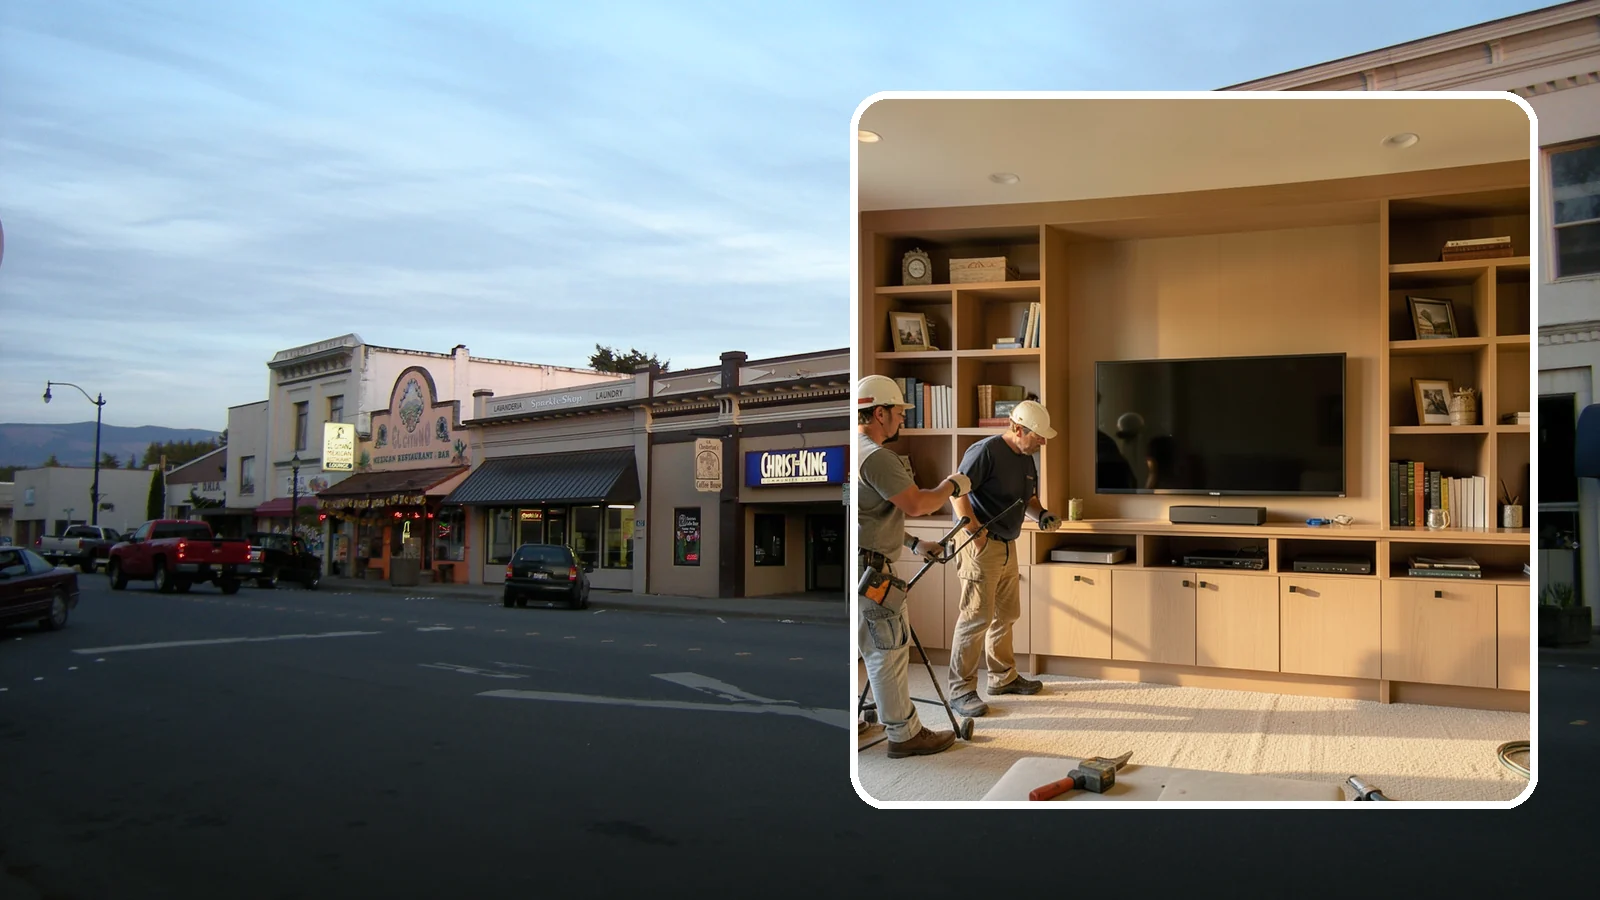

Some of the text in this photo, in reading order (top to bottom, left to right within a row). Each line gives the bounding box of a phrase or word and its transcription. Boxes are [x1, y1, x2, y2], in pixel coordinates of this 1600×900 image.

[561, 394, 583, 405] Shop
[595, 389, 623, 400] LAUNDRY
[493, 402, 522, 413] LAVANDERIA
[373, 454, 396, 464] MEXICAN
[397, 451, 433, 462] RESTAURANT
[437, 450, 450, 459] BAR
[799, 450, 827, 476] KING
[696, 480, 722, 489] Coffee House
